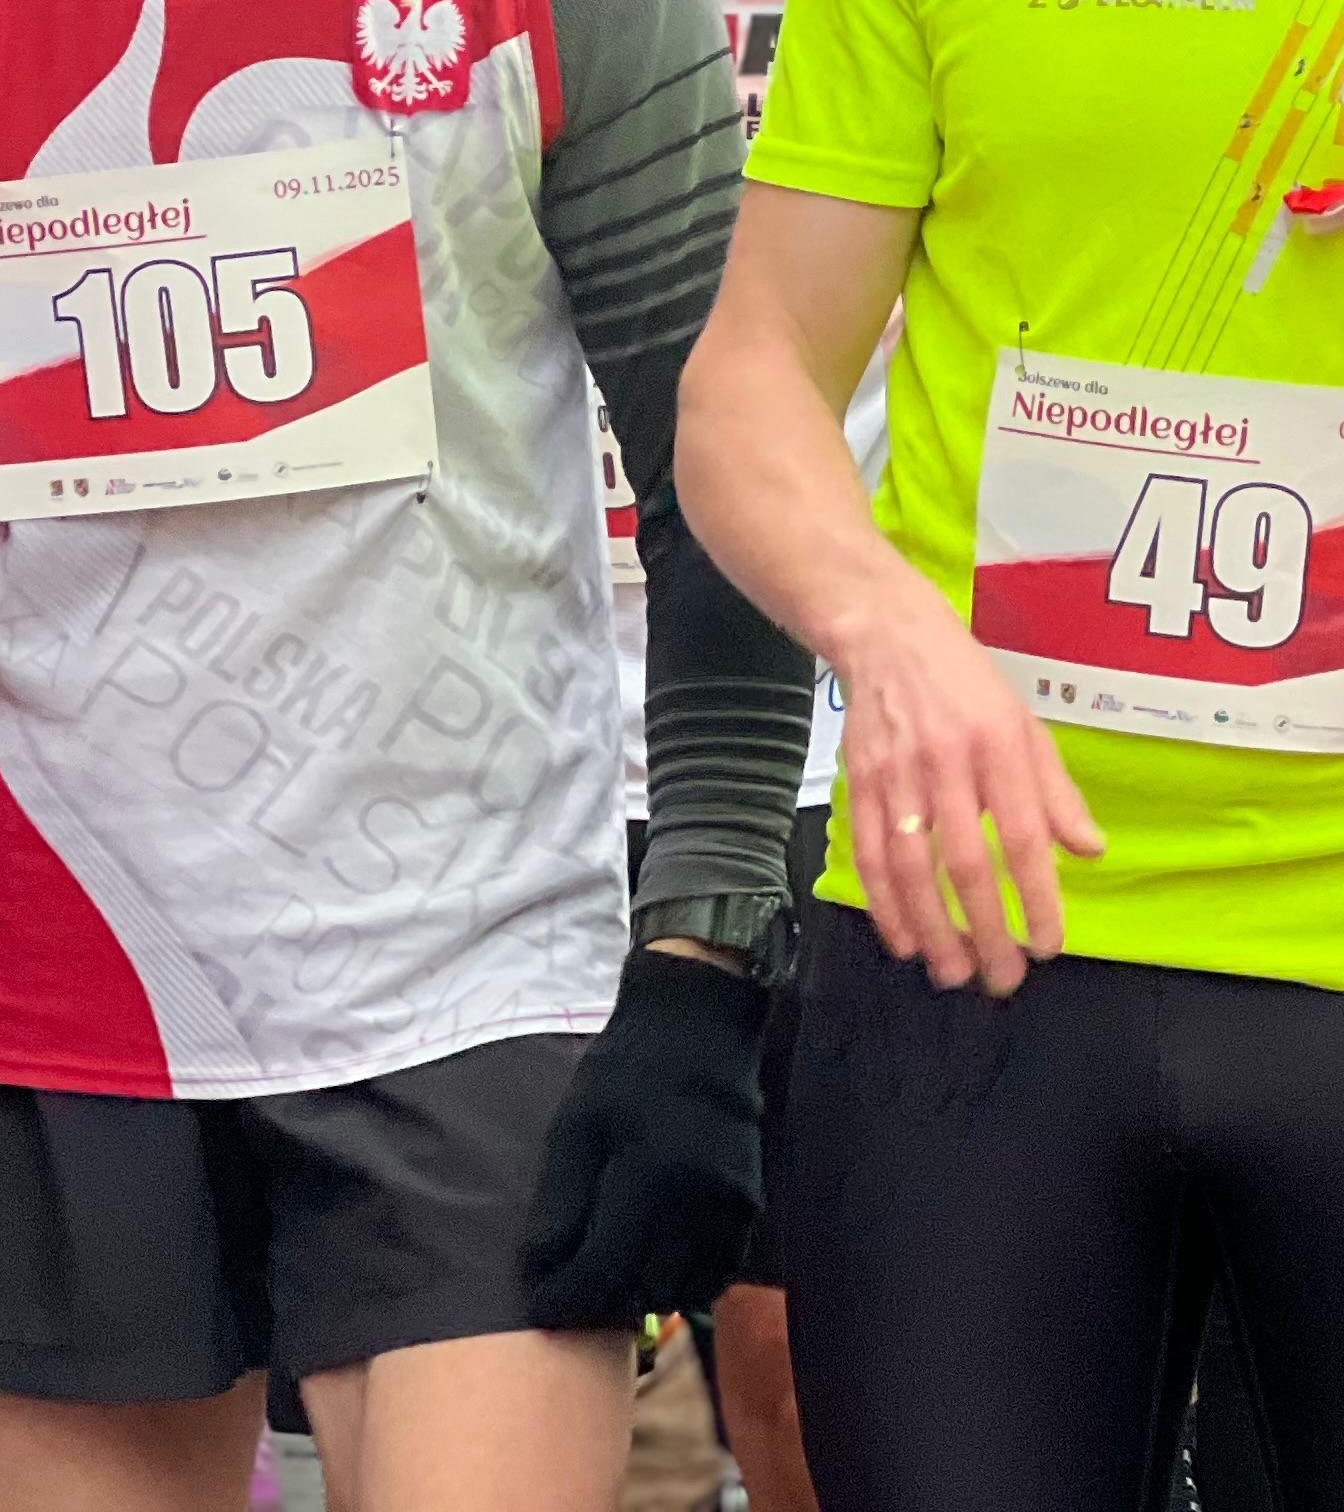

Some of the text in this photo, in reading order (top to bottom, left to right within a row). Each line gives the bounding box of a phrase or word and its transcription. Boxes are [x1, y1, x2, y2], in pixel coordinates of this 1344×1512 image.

[36, 195, 59, 208] dla
[273, 165, 401, 200] 09.11.2025
[51, 245, 316, 421] 105
[1084, 380, 1109, 396] dla
[1011, 391, 1250, 456] Niepodległej
[1105, 472, 1314, 651] 49
[135, 565, 383, 751] POLSKA
